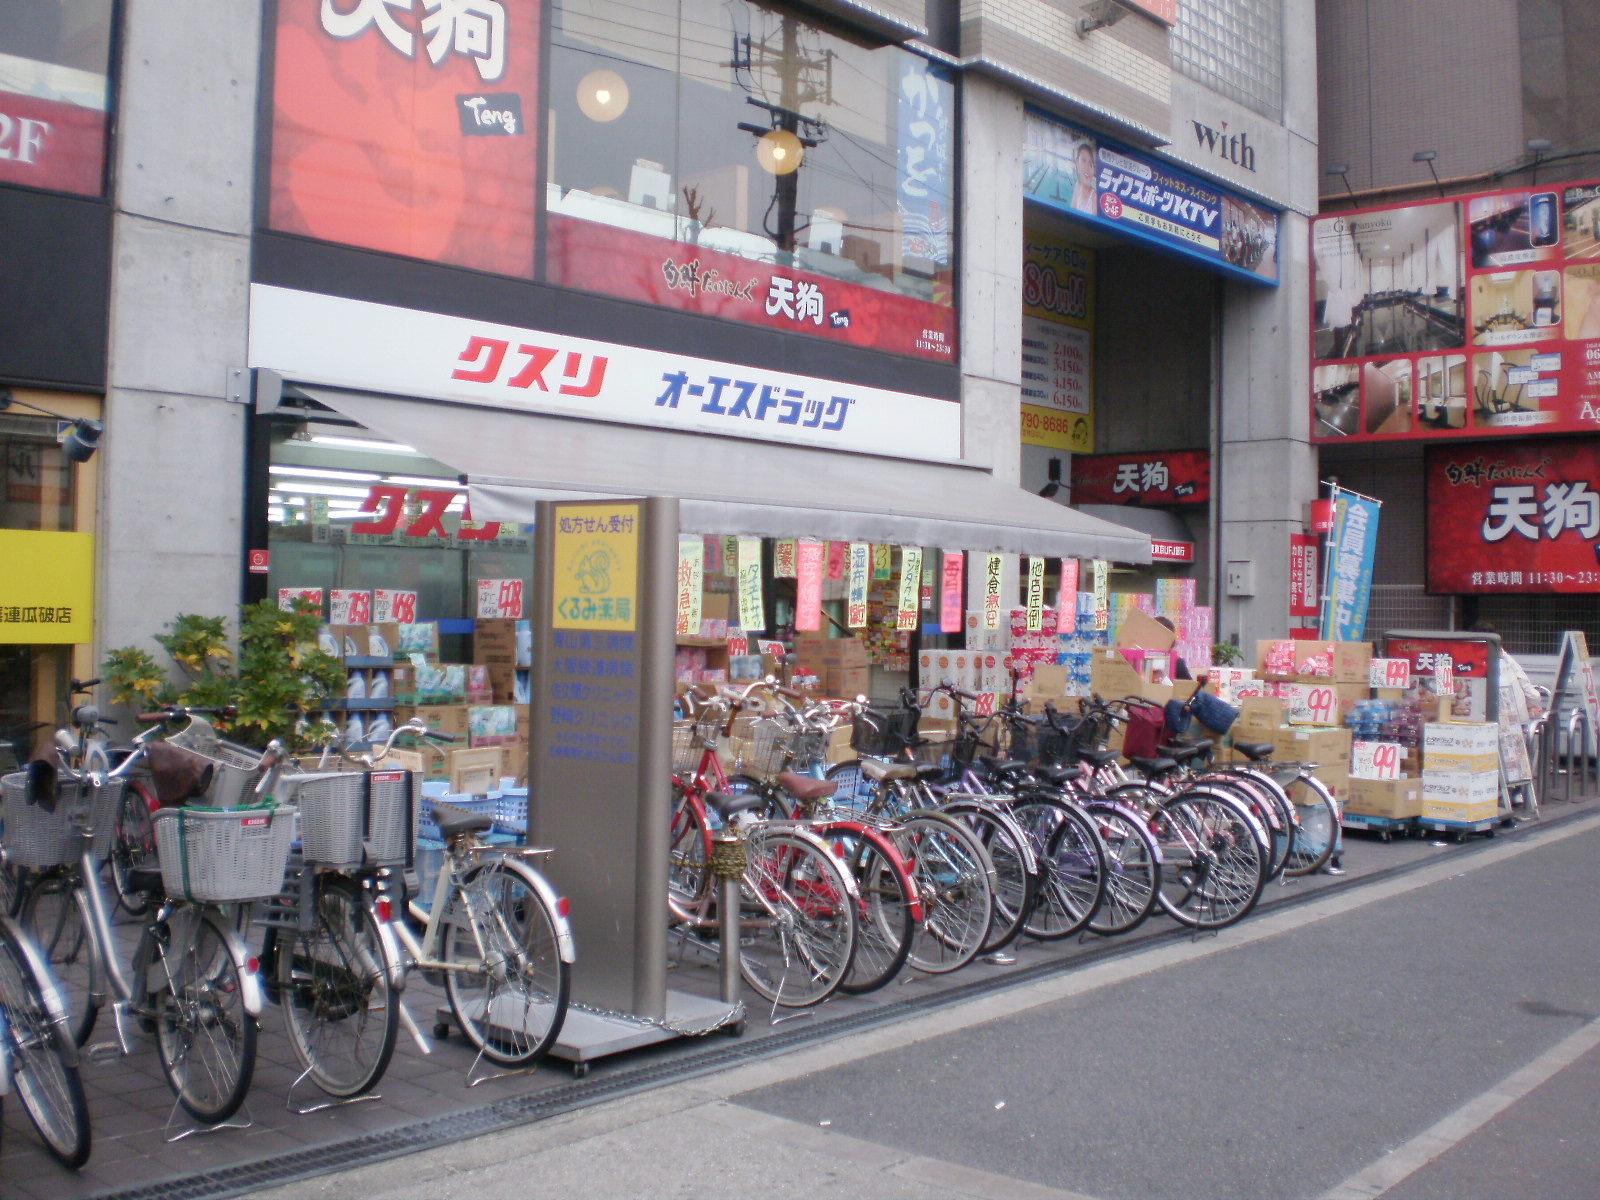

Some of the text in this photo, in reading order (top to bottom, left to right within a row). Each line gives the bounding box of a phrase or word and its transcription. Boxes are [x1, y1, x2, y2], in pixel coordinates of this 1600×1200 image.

[1192, 119, 1257, 173] with
[1099, 167, 1219, 228] ライフスポーツKTV
[766, 276, 824, 326] 天狗
[451, 335, 607, 397] クスリ
[655, 370, 856, 429] オーエスドラッグ
[1112, 461, 1169, 494] 天狗
[559, 514, 635, 534] 処方せん受付
[1483, 482, 1600, 541] 天狗
[1472, 572, 1600, 585] 営業時間 11:30〜23:
[0, 606, 72, 623] 連瓜破店
[558, 597, 631, 622] くるみ薬局
[1416, 652, 1453, 670] 天狗
[1372, 744, 1398, 779] 99
